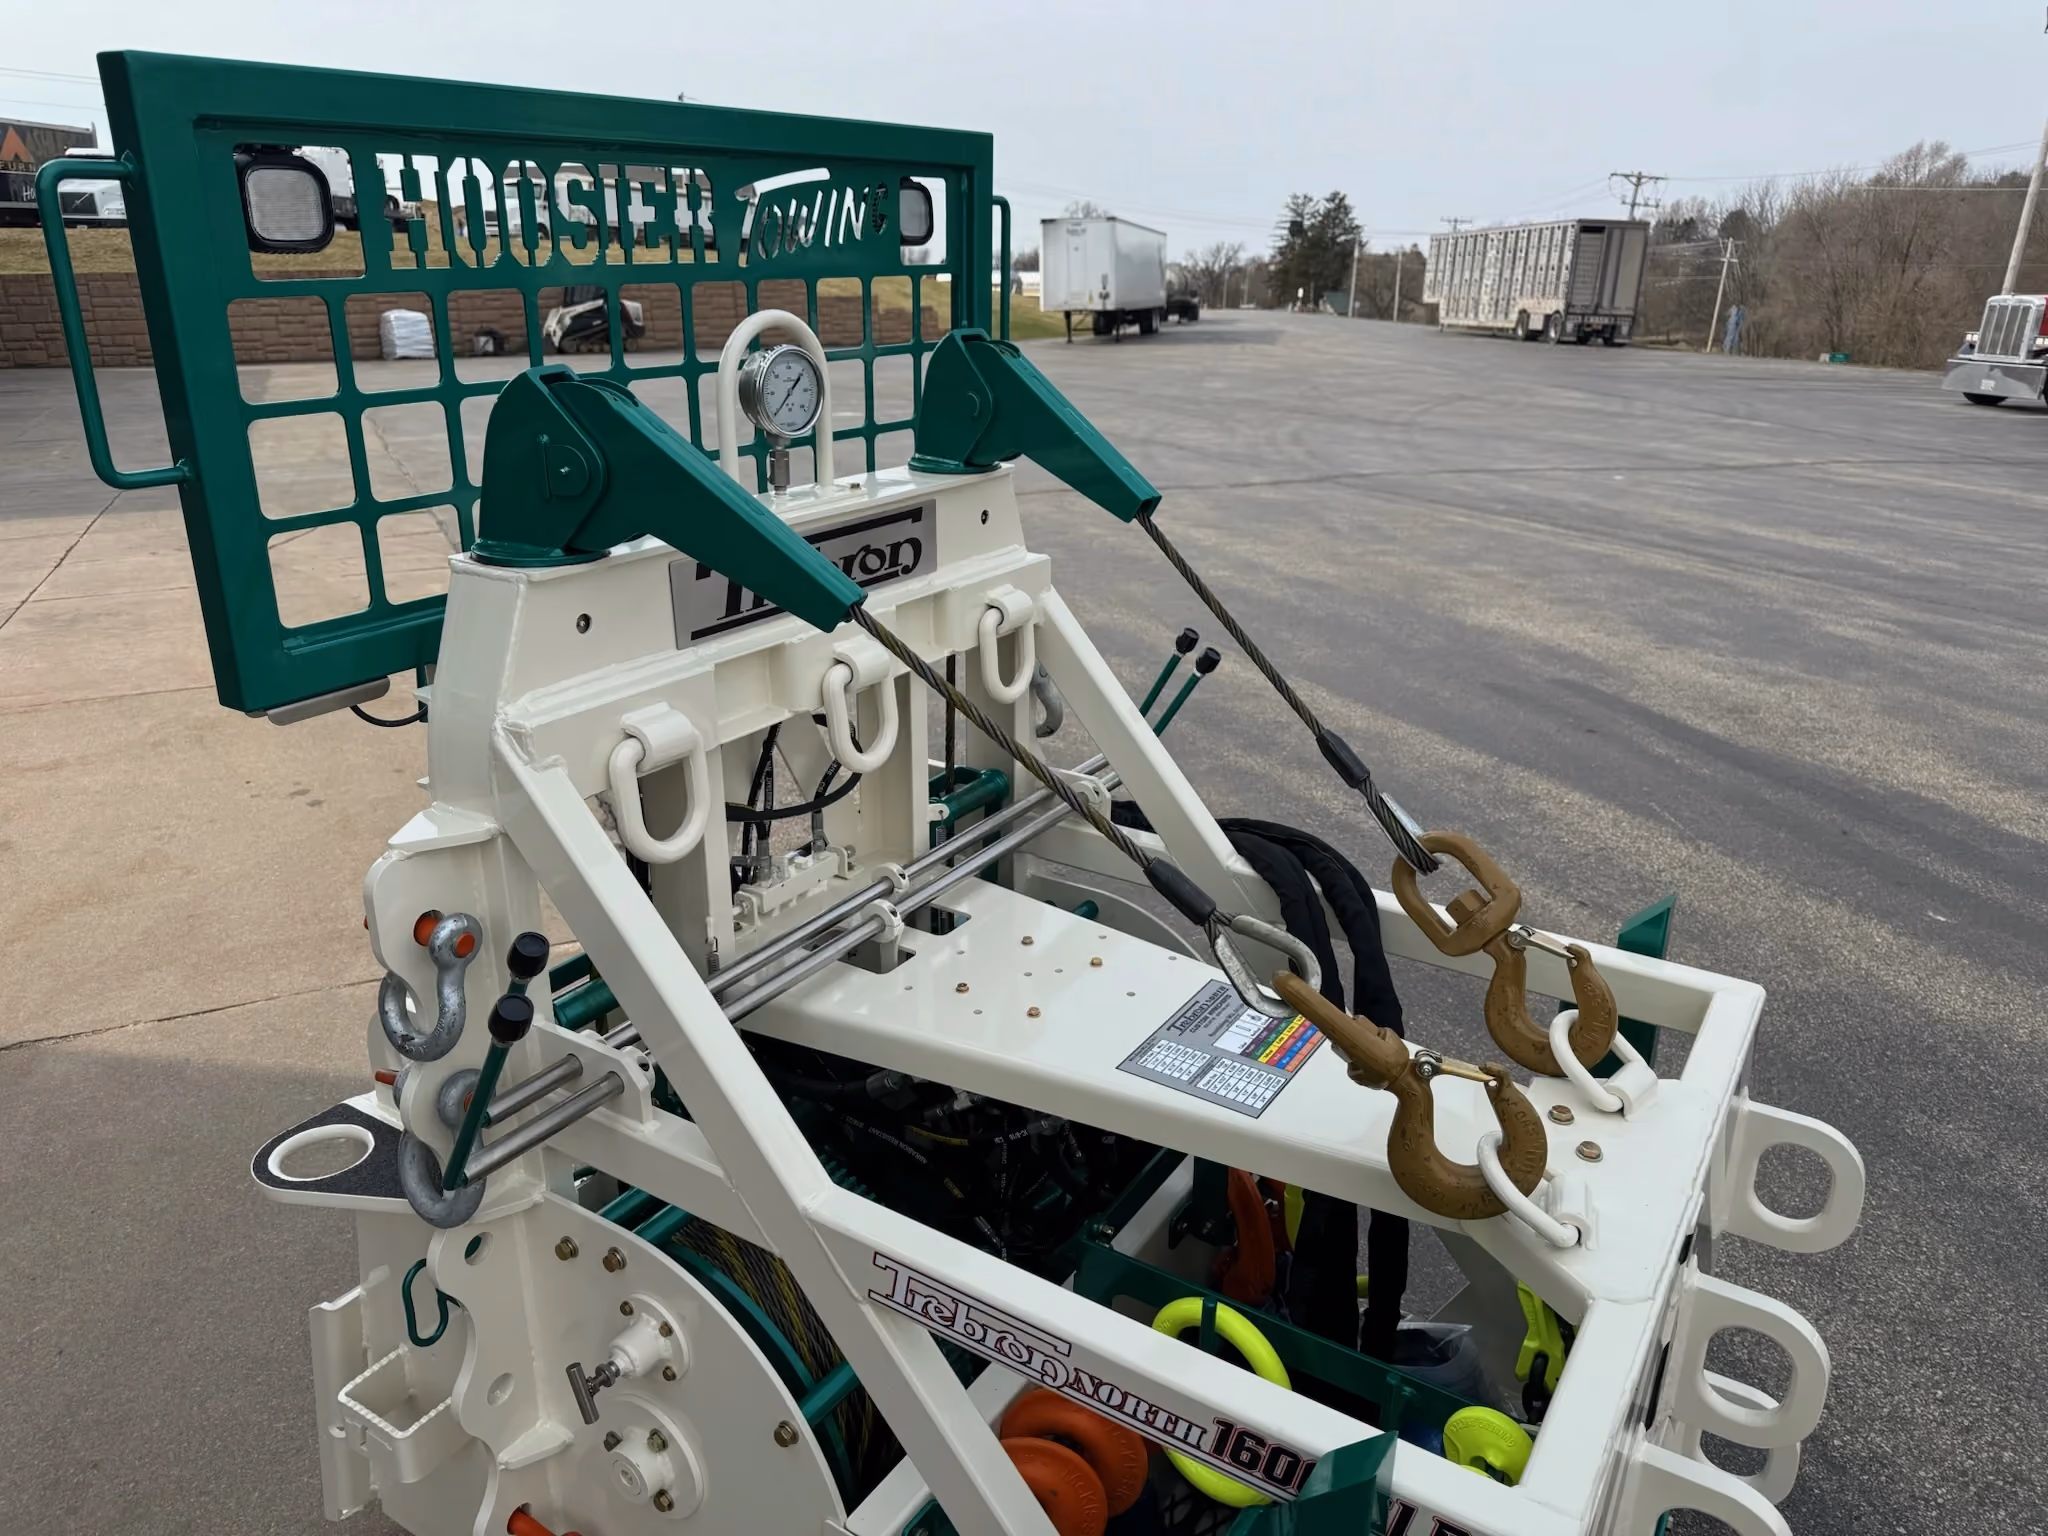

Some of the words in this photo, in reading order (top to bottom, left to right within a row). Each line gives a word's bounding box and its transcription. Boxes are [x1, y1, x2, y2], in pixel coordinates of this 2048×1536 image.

[375, 152, 719, 270] HOOSIER
[734, 167, 889, 268] TOWING
[869, 1251, 1072, 1389] Trebron
[1070, 1367, 1208, 1450] NORTH
[1209, 1416, 1317, 1496] 160
